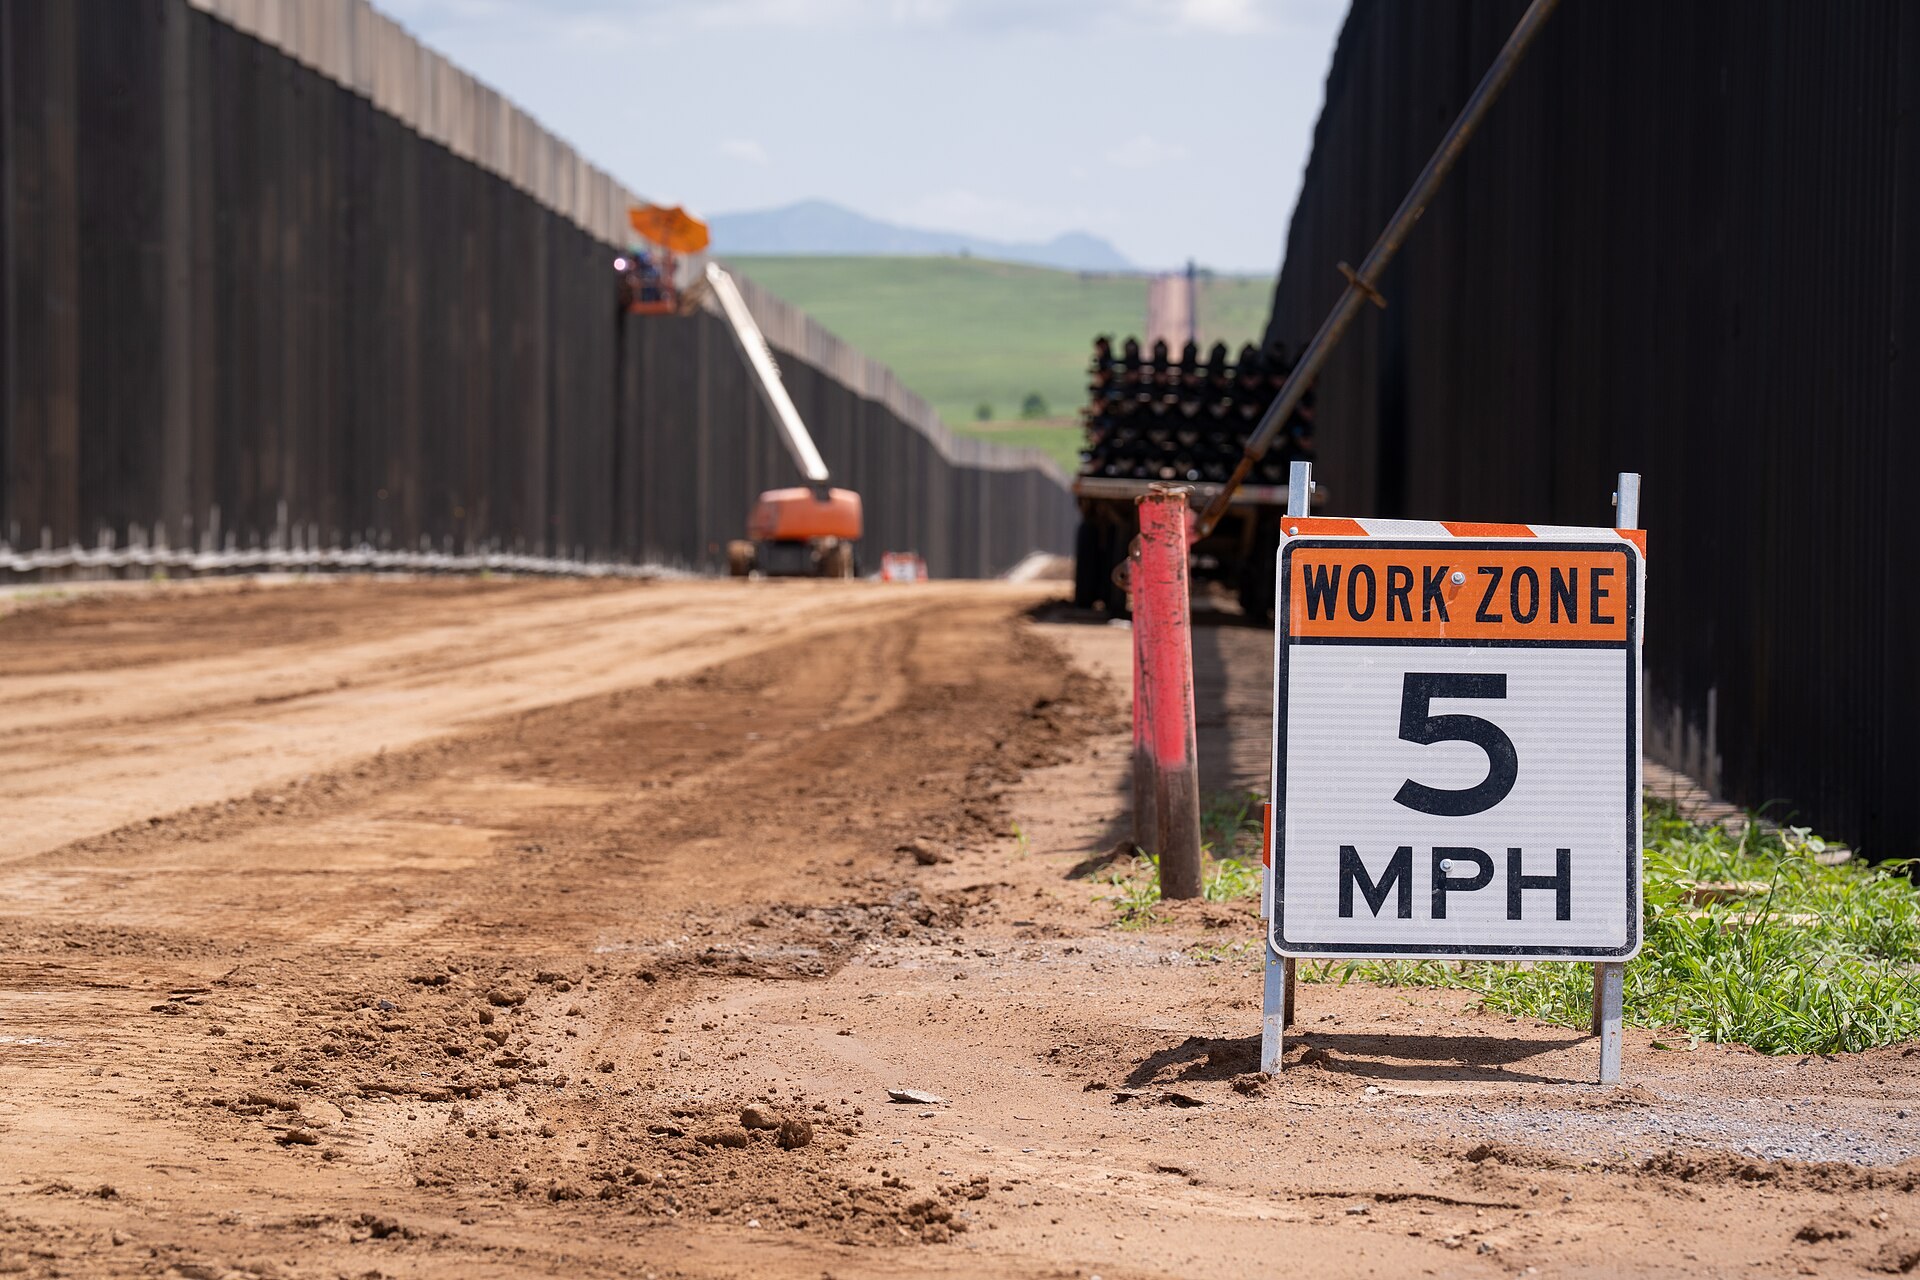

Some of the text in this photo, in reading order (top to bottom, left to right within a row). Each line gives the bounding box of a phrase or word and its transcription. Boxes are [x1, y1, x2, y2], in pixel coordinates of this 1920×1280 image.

[1303, 564, 1615, 624] WORK ZONE
[1393, 672, 1519, 816] 5
[1338, 845, 1571, 921] MPH
